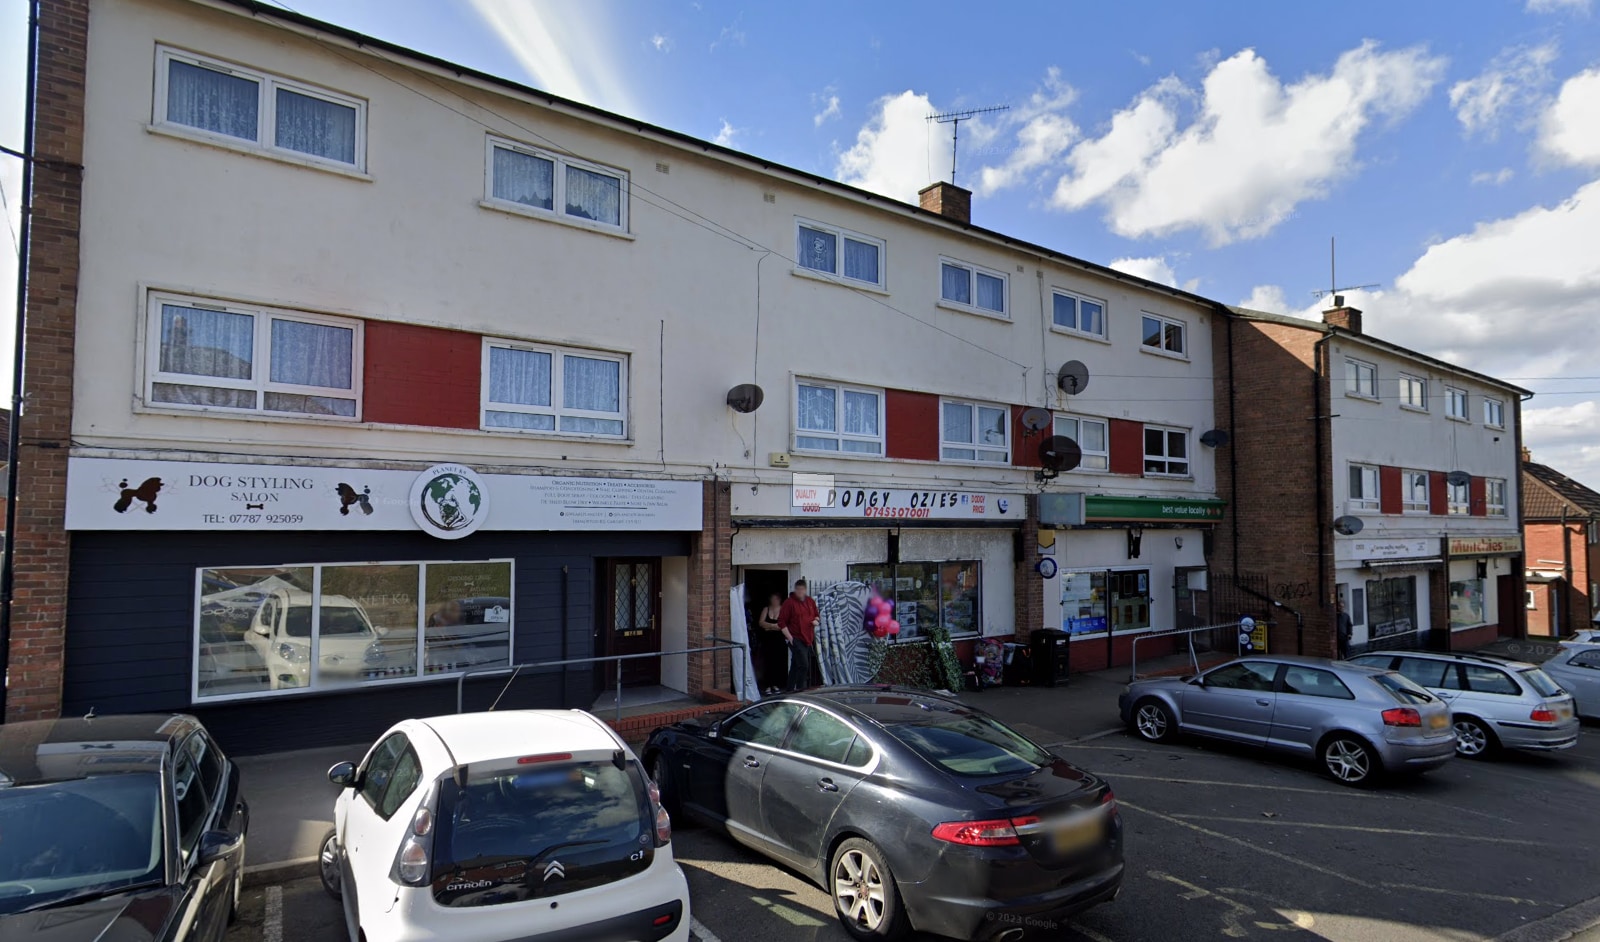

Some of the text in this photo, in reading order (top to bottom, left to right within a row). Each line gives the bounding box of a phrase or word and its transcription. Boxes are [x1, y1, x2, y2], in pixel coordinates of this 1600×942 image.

[189, 475, 314, 489] DOG STYLING
[231, 492, 279, 502] SALON
[795, 489, 816, 500] QUALITY
[827, 489, 890, 508] DODGY
[865, 507, 930, 518] 07455070011
[1162, 505, 1173, 514] best
[1188, 507, 1205, 516] locally
[202, 514, 304, 524] TEL: 07787 925059
[630, 850, 644, 861] C1
[446, 879, 492, 891] CITROËN
